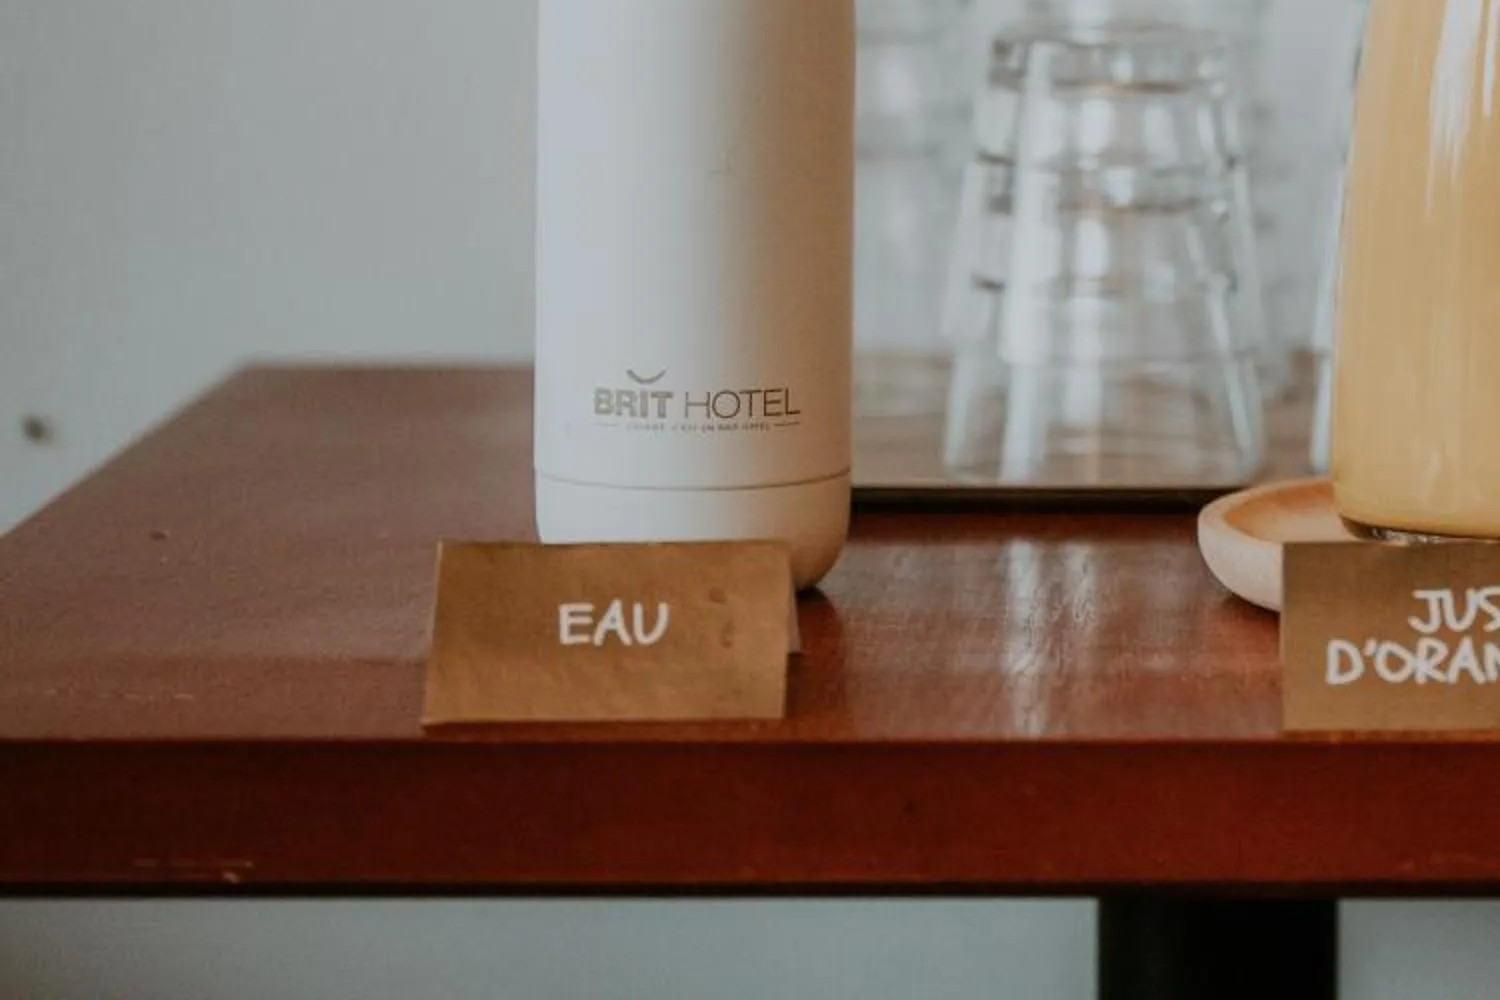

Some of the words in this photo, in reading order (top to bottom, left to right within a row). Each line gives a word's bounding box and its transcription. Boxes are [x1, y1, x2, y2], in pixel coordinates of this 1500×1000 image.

[594, 387, 674, 419] BRIT
[684, 388, 801, 419] HOTEL
[557, 599, 670, 646] EAU
